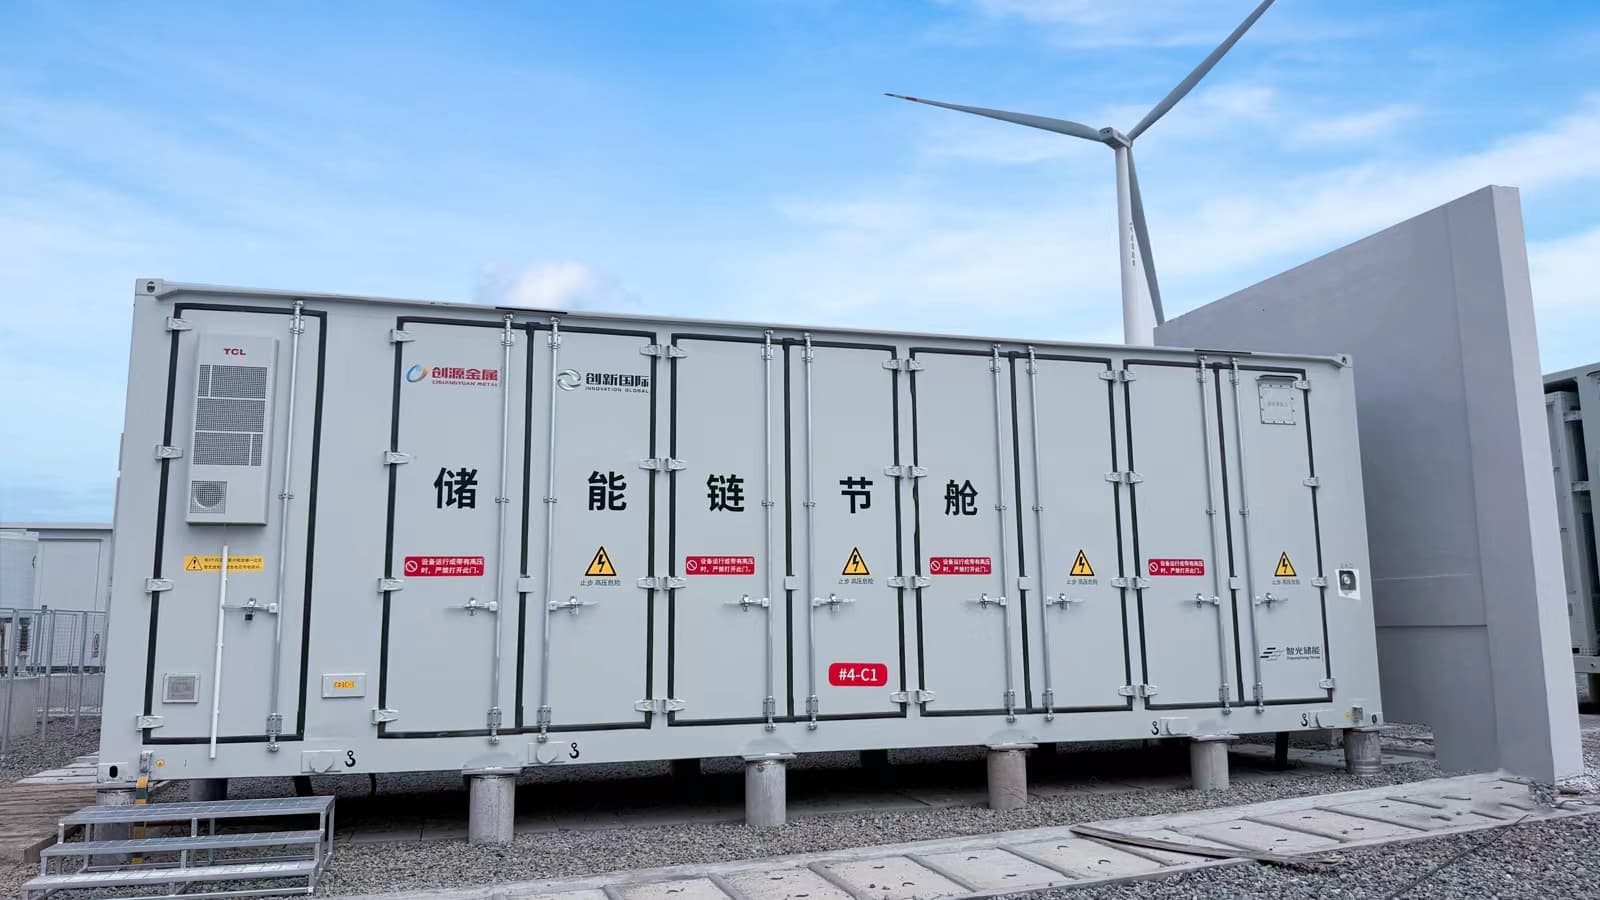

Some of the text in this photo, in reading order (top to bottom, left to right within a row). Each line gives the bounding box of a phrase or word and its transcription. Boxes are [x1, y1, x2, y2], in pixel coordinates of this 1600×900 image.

[223, 348, 246, 356] TCL
[432, 367, 498, 381] 创源金属
[586, 372, 649, 388] 创新国际
[434, 467, 978, 516] 储 能 链 节 舱
[1286, 646, 1321, 656] 智光储能
[838, 667, 879, 682] #4-C1
